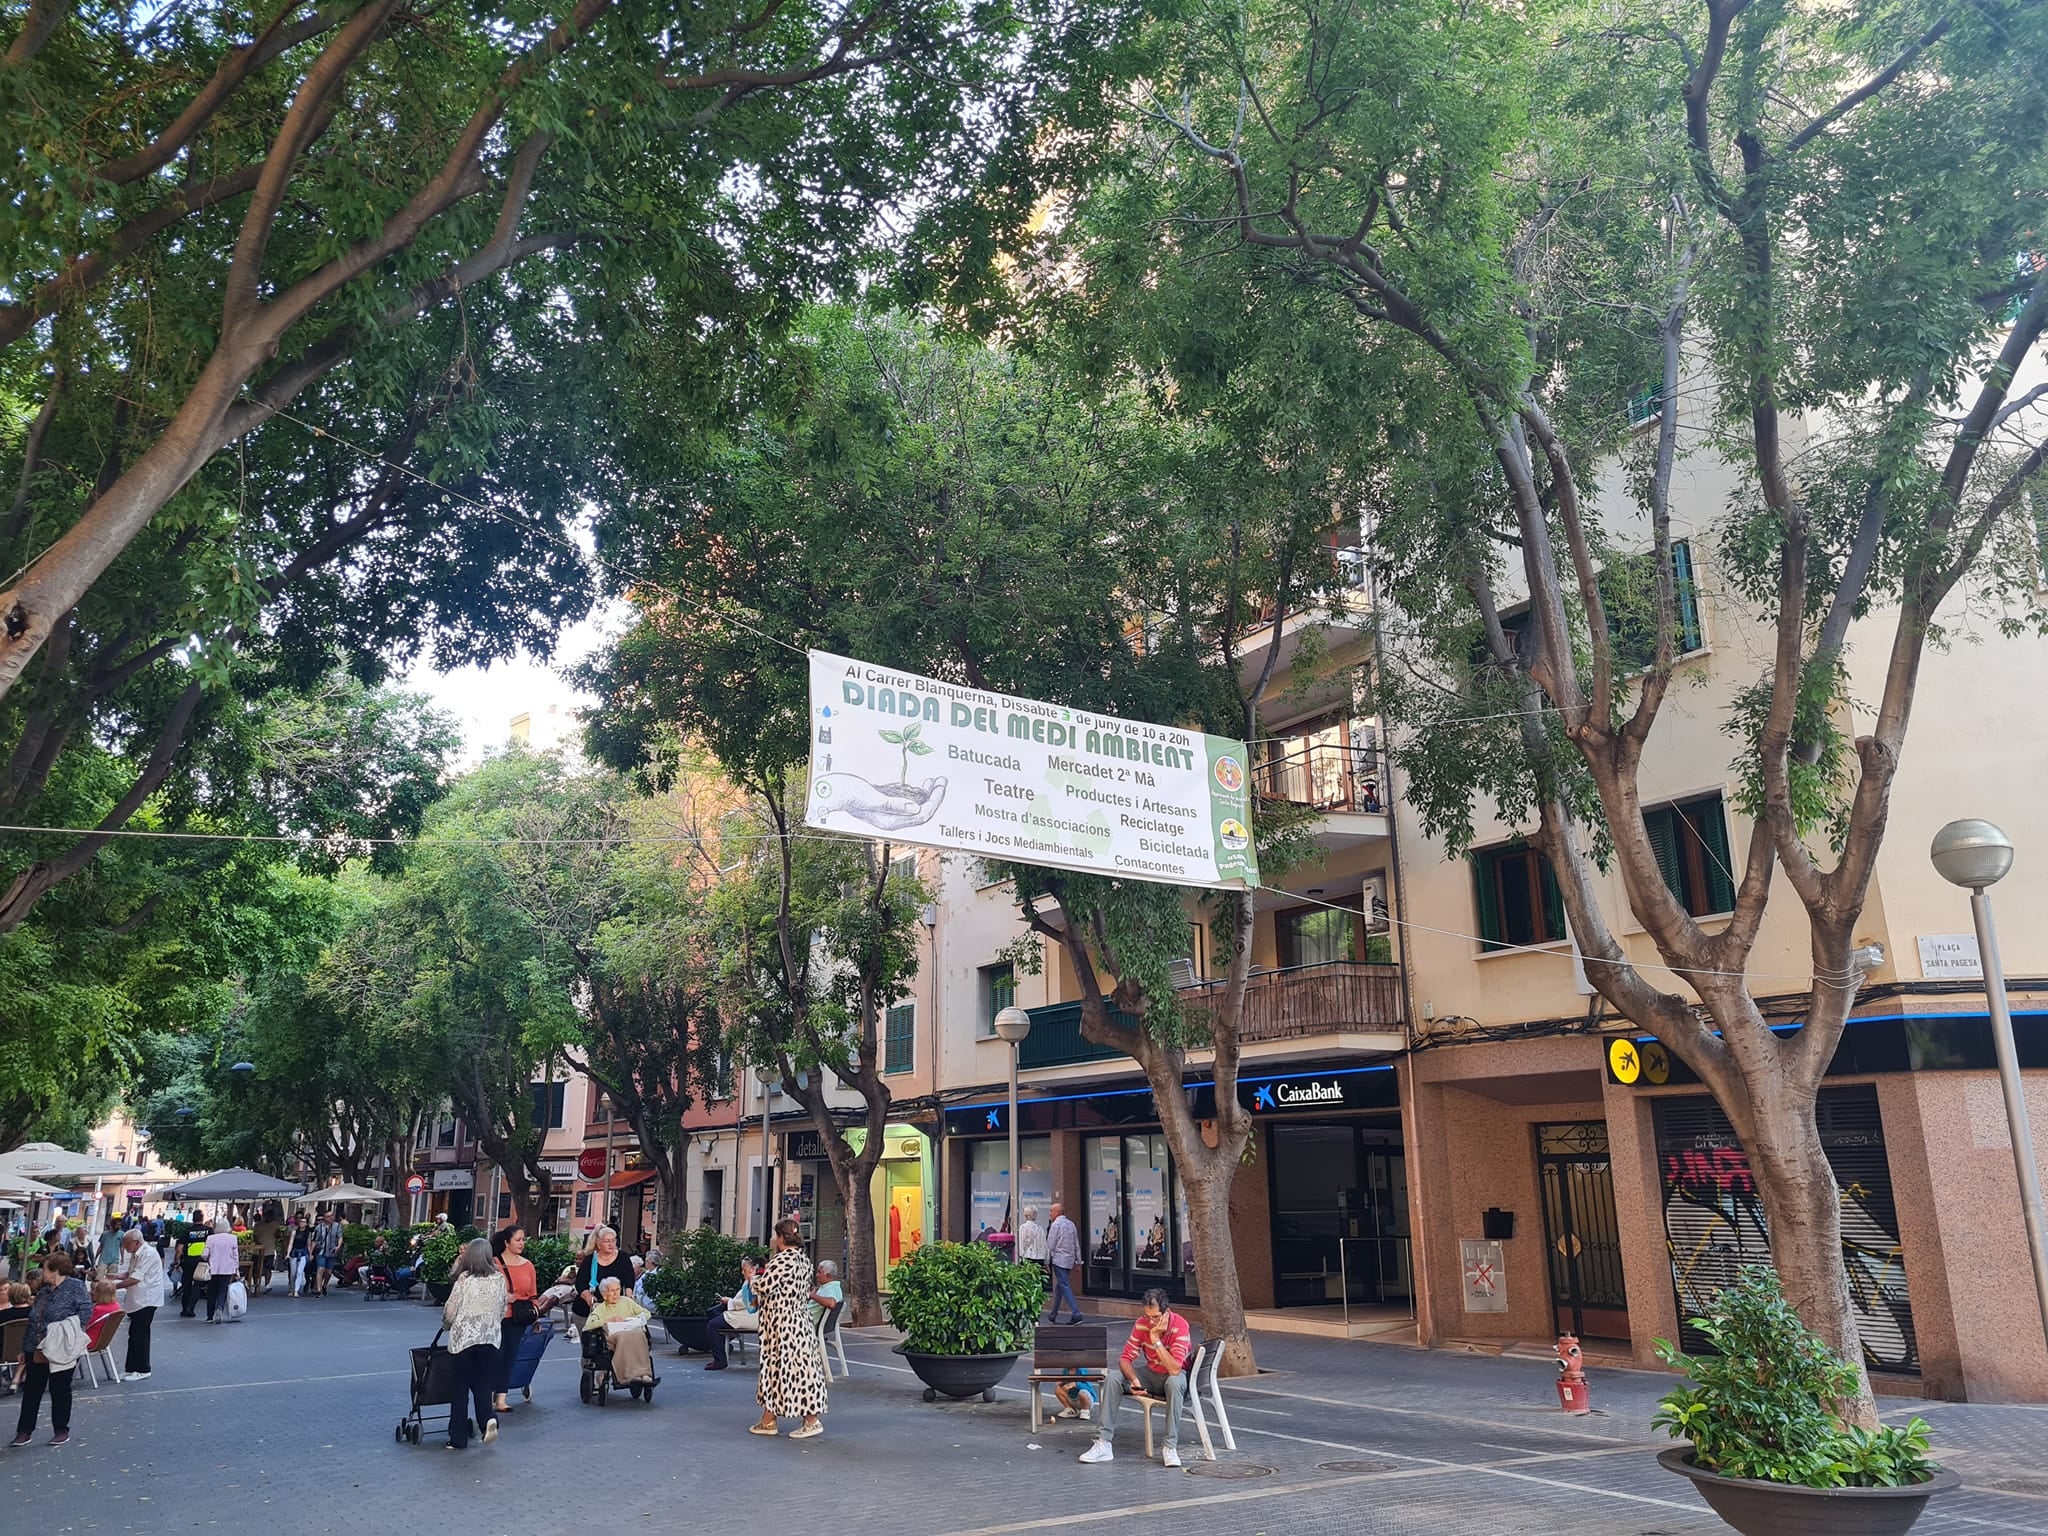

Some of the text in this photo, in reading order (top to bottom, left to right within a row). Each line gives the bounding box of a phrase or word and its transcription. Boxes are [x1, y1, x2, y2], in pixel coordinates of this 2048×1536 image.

[845, 665, 861, 679] Al
[865, 669, 911, 688] Carrer
[915, 679, 998, 708] Blanquerna,
[1002, 697, 1058, 719] Dissabte
[1076, 713, 1091, 726] de
[1094, 716, 1121, 734] juny
[1124, 723, 1139, 736] de
[1142, 726, 1156, 739] 10
[1159, 732, 1166, 741] a
[1168, 732, 1190, 746] 20h
[842, 680, 1194, 771] DIADA DEL MEDI AMBIENT
[948, 744, 1022, 772] Batucada
[1048, 755, 1156, 787] Mercadet 2ª Mà
[984, 778, 1035, 801] Teatre
[1066, 784, 1132, 809] Productes
[1135, 796, 1139, 808] i
[1142, 798, 1198, 818] Artesans
[975, 804, 1111, 838] Mostra d'associacions
[1120, 814, 1184, 837] Reciclatge
[939, 824, 976, 841] Tallers
[985, 831, 1011, 846] Jocs
[1014, 836, 1094, 860] Mediambientals
[1139, 838, 1210, 860] Bicicletada
[1114, 854, 1185, 875] Contacontes
[1937, 944, 1961, 952] PLAÇA
[1926, 959, 1978, 968] SANTA PAGESA
[1278, 1080, 1344, 1102] CaixaBank
